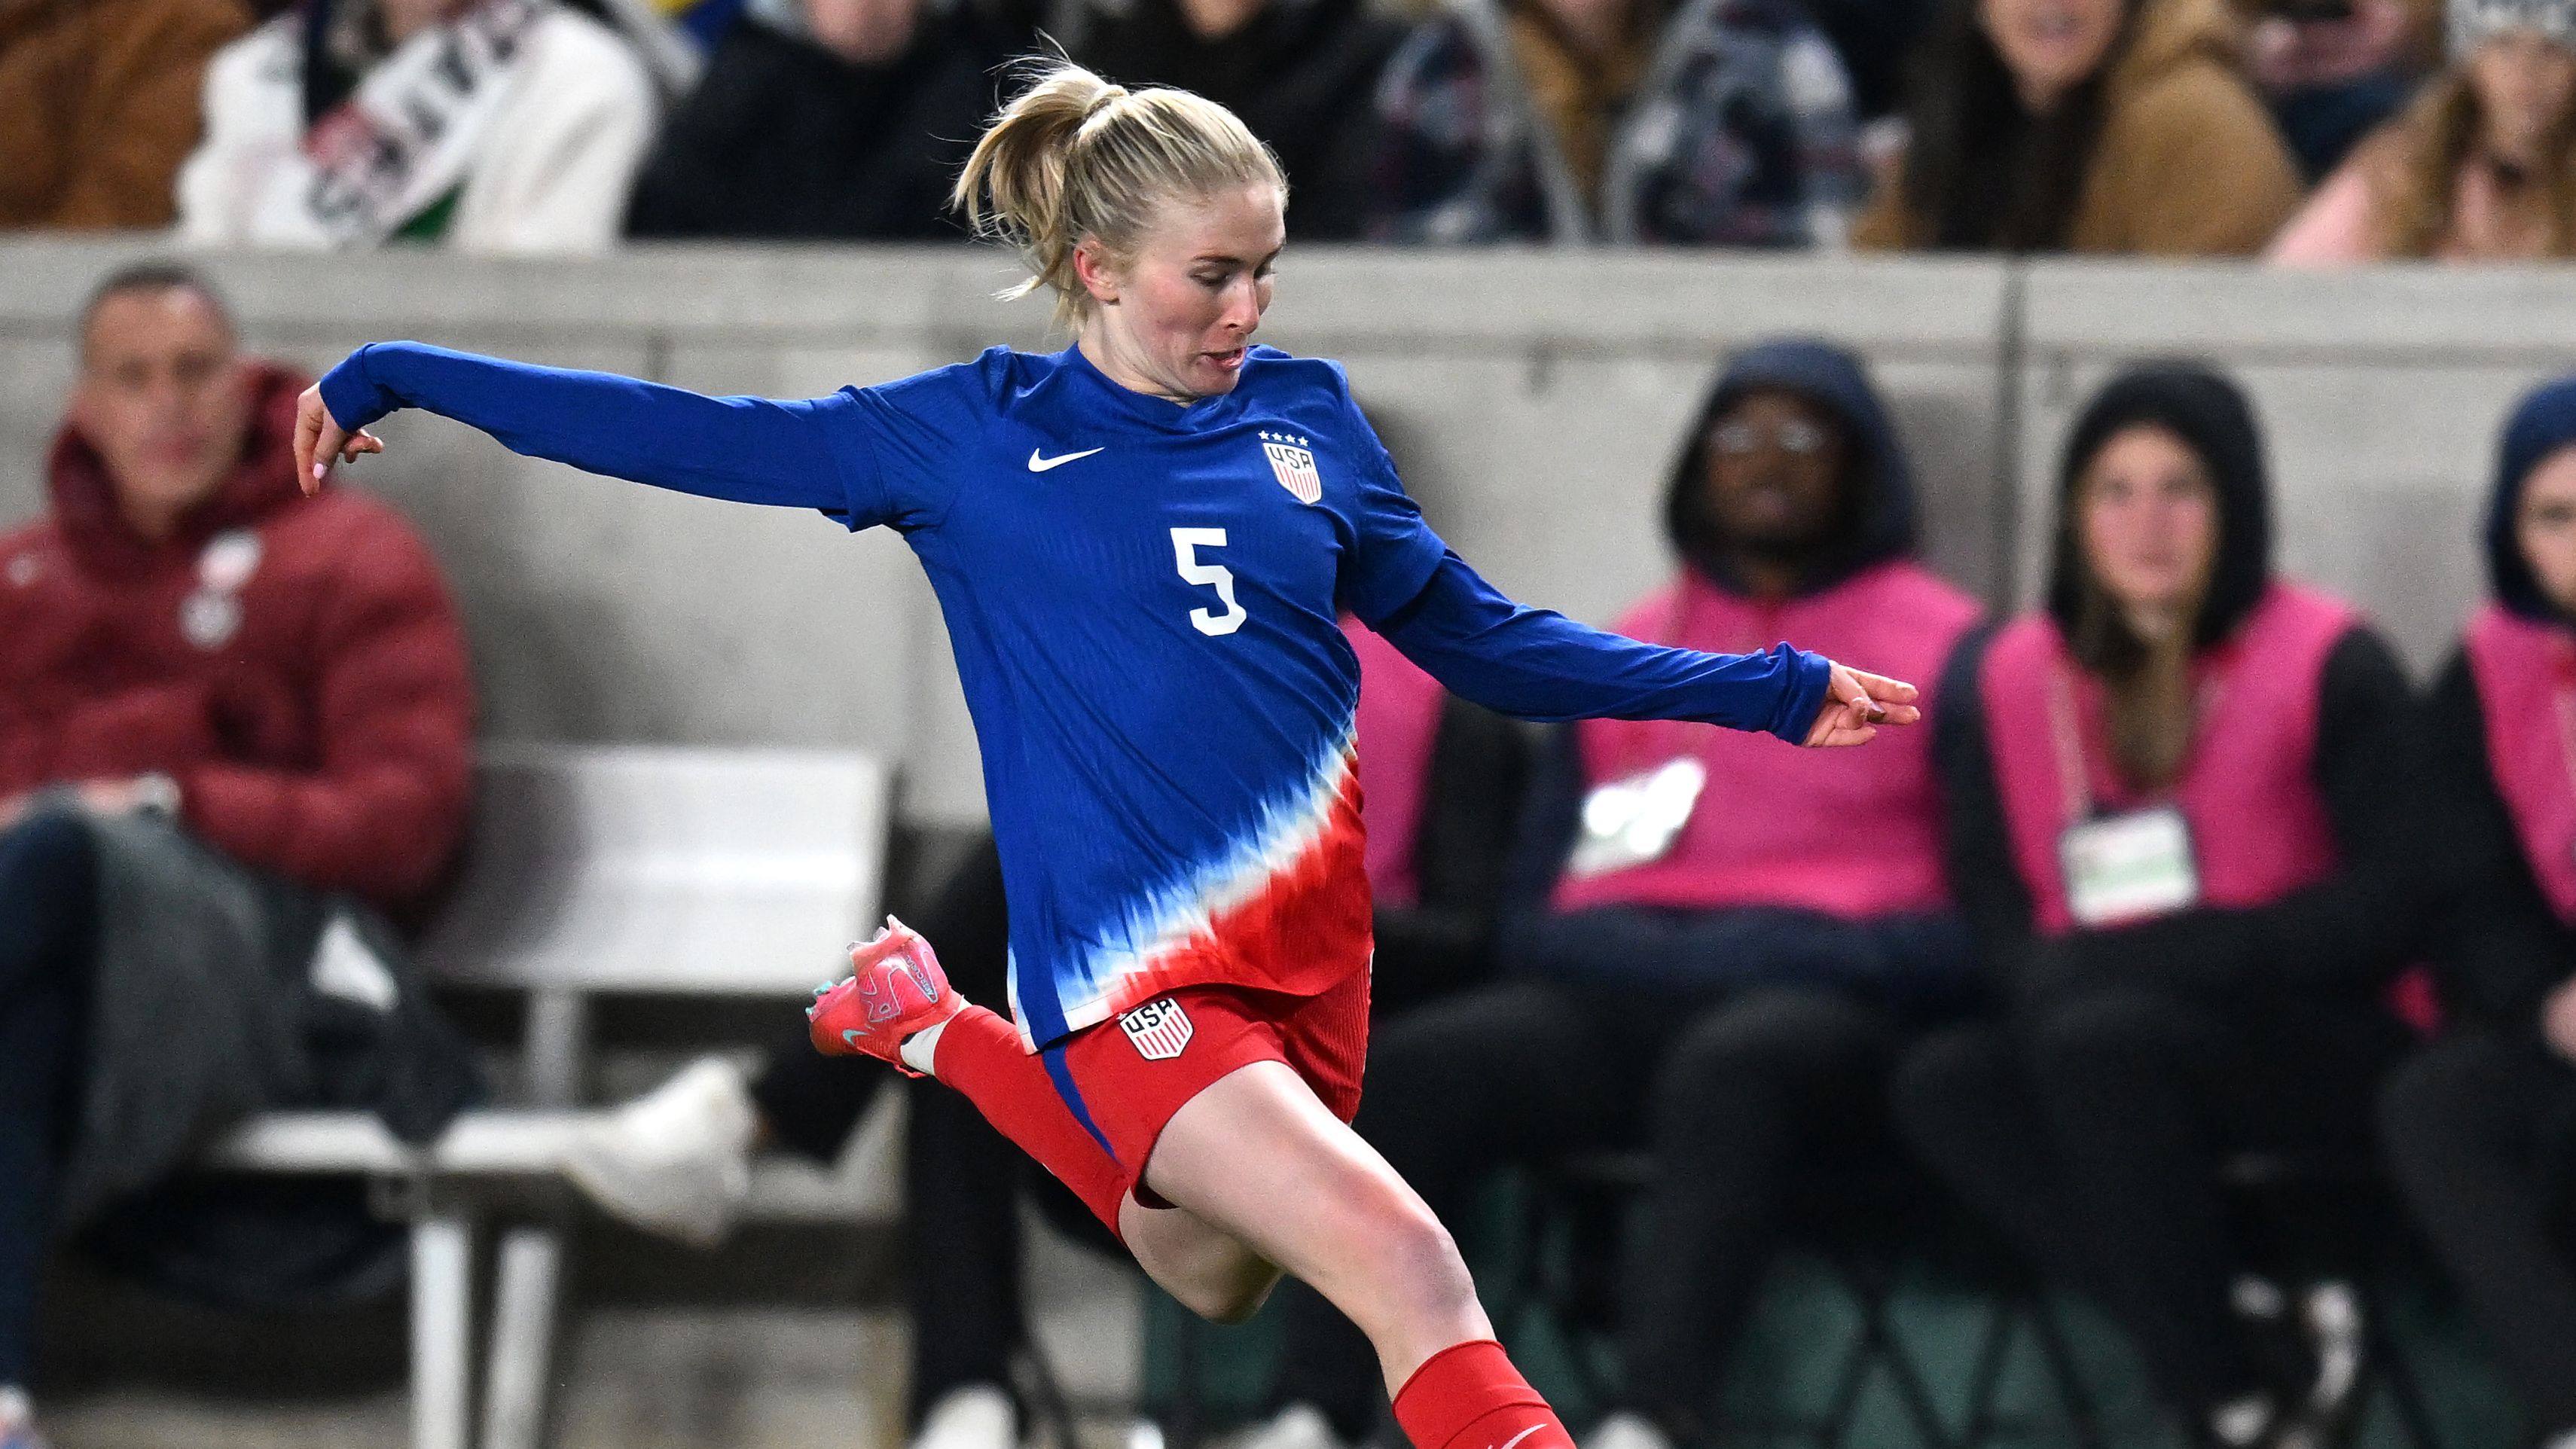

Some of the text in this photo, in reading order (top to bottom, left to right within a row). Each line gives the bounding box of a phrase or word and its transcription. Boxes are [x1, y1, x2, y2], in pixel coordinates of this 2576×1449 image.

[1268, 446, 1312, 469] USA
[1170, 527, 1247, 636] 5
[1125, 999, 1173, 1033] USA
